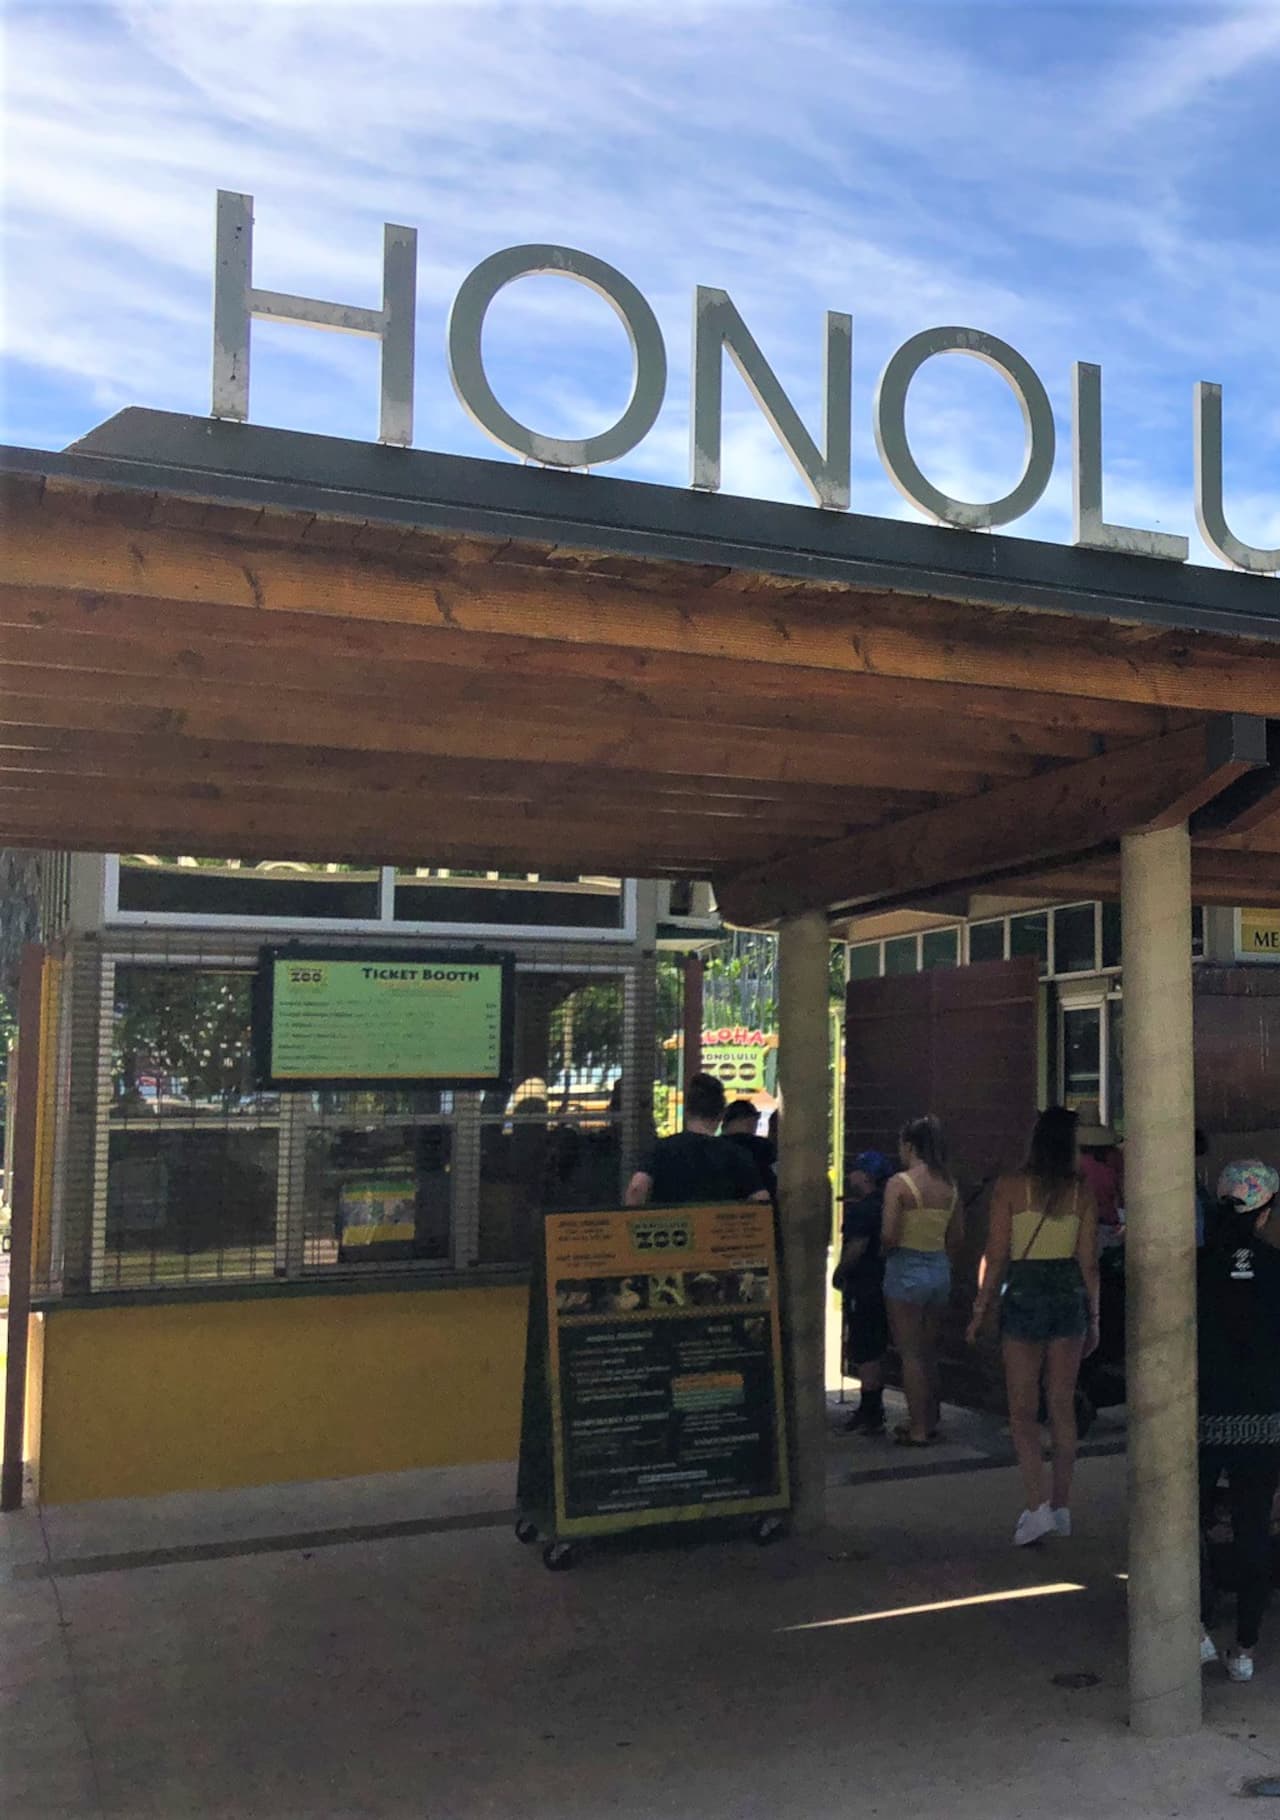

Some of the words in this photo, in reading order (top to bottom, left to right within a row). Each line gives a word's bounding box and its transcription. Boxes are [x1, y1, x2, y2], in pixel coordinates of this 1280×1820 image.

[290, 972, 322, 983] ZOO
[362, 967, 418, 980] TICKET
[422, 968, 480, 982] BOOTH
[702, 1027, 764, 1044] LOHA
[702, 1053, 758, 1061] ONOLULU
[636, 1230, 689, 1249] ZOO
